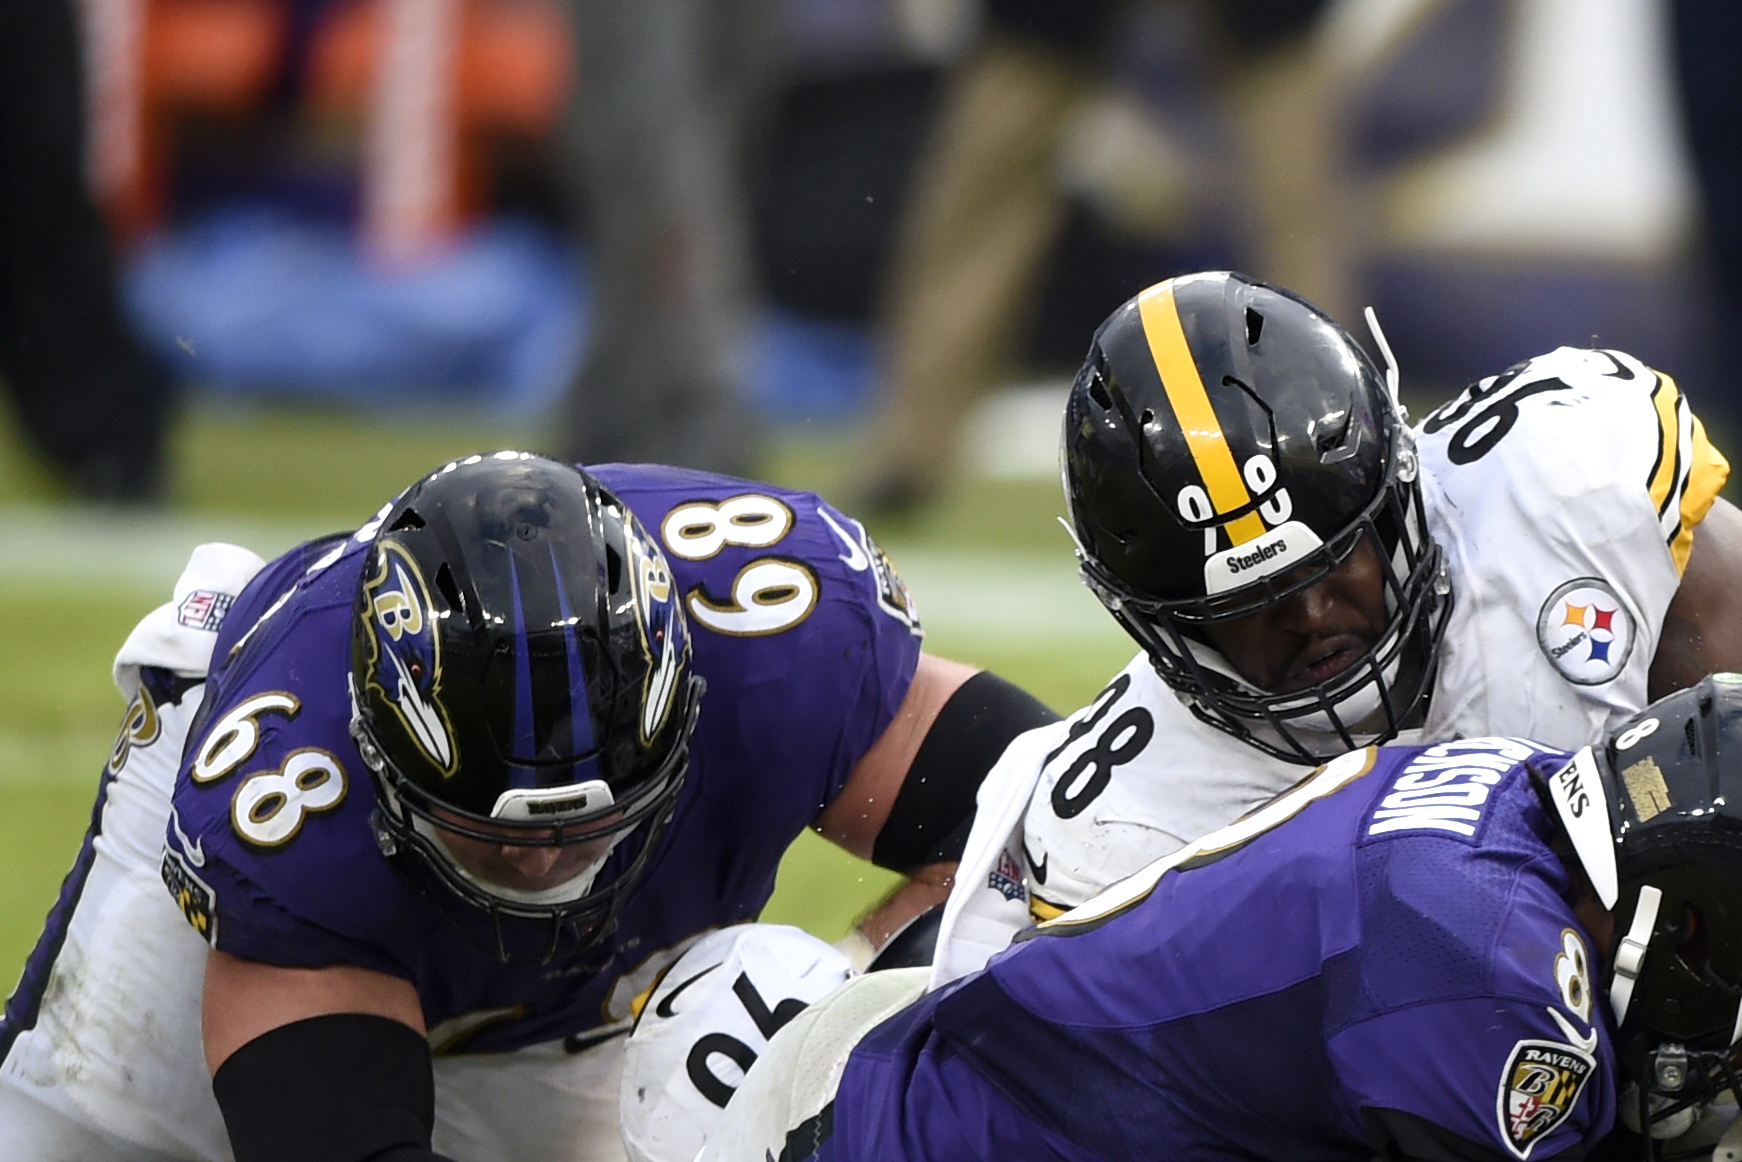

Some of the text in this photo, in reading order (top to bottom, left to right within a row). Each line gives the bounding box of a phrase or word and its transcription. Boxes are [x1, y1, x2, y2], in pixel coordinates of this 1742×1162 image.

[1177, 454, 1293, 557] 98
[661, 494, 820, 637] 68
[1226, 539, 1288, 574] Steelers
[1550, 631, 1588, 659] Steelers
[1615, 717, 1660, 751] 8
[190, 690, 349, 848] 68
[1553, 926, 1593, 1024] 8
[1524, 1048, 1588, 1075] RAVENS
